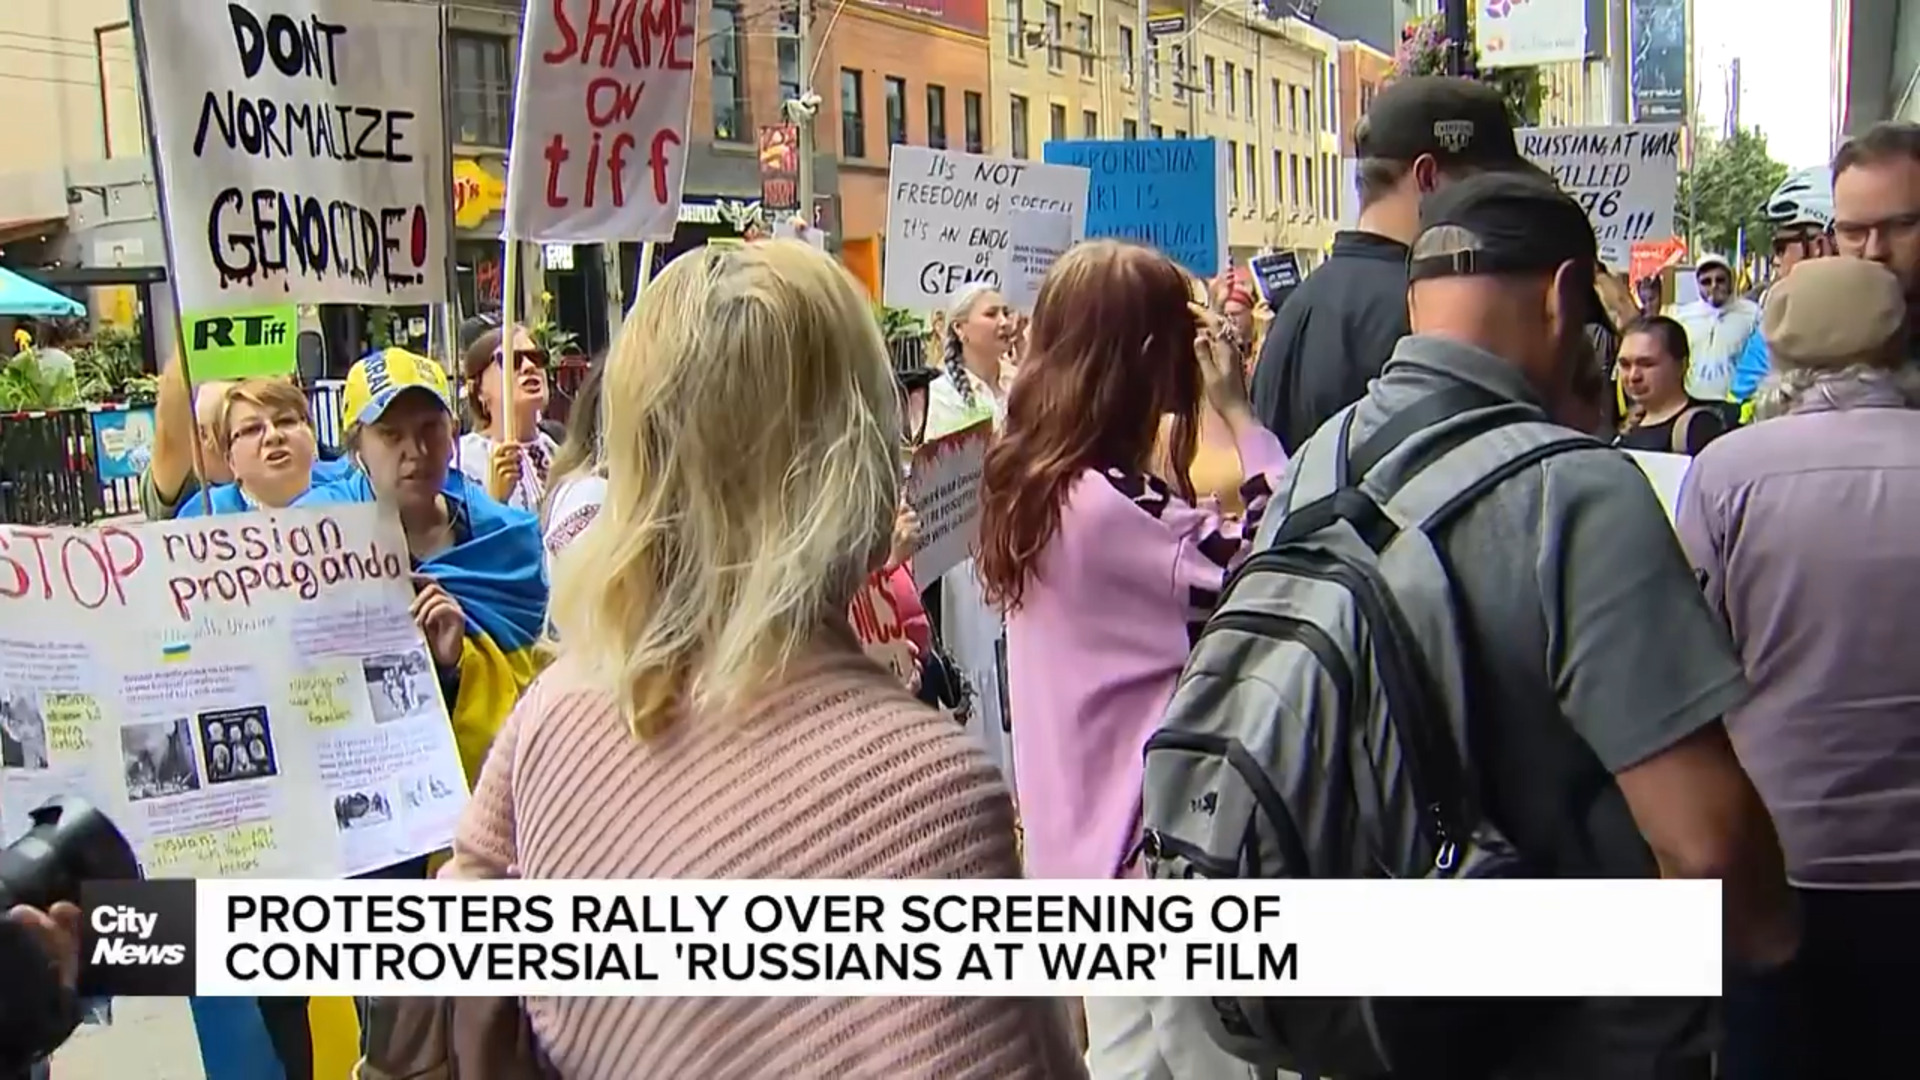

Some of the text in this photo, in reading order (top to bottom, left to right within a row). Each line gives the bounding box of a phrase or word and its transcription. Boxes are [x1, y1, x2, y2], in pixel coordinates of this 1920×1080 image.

[228, 3, 347, 85] DONT
[544, 0, 694, 69] SHAME
[586, 77, 645, 127] ON
[193, 90, 415, 162] NORMALIZE
[1608, 131, 1639, 157] AT
[544, 129, 681, 208] tiff
[974, 162, 1025, 188] NOT
[1551, 163, 1631, 188] KILLED
[897, 182, 978, 211] FREEDOM
[985, 197, 1000, 213] of
[1566, 189, 1621, 218] 76
[208, 187, 428, 294] GENOCIDE!
[939, 224, 961, 244] AN
[975, 250, 993, 266] of
[193, 315, 286, 351] RTiff
[0, 516, 342, 609] STOP russian
[168, 542, 401, 622] propaganda
